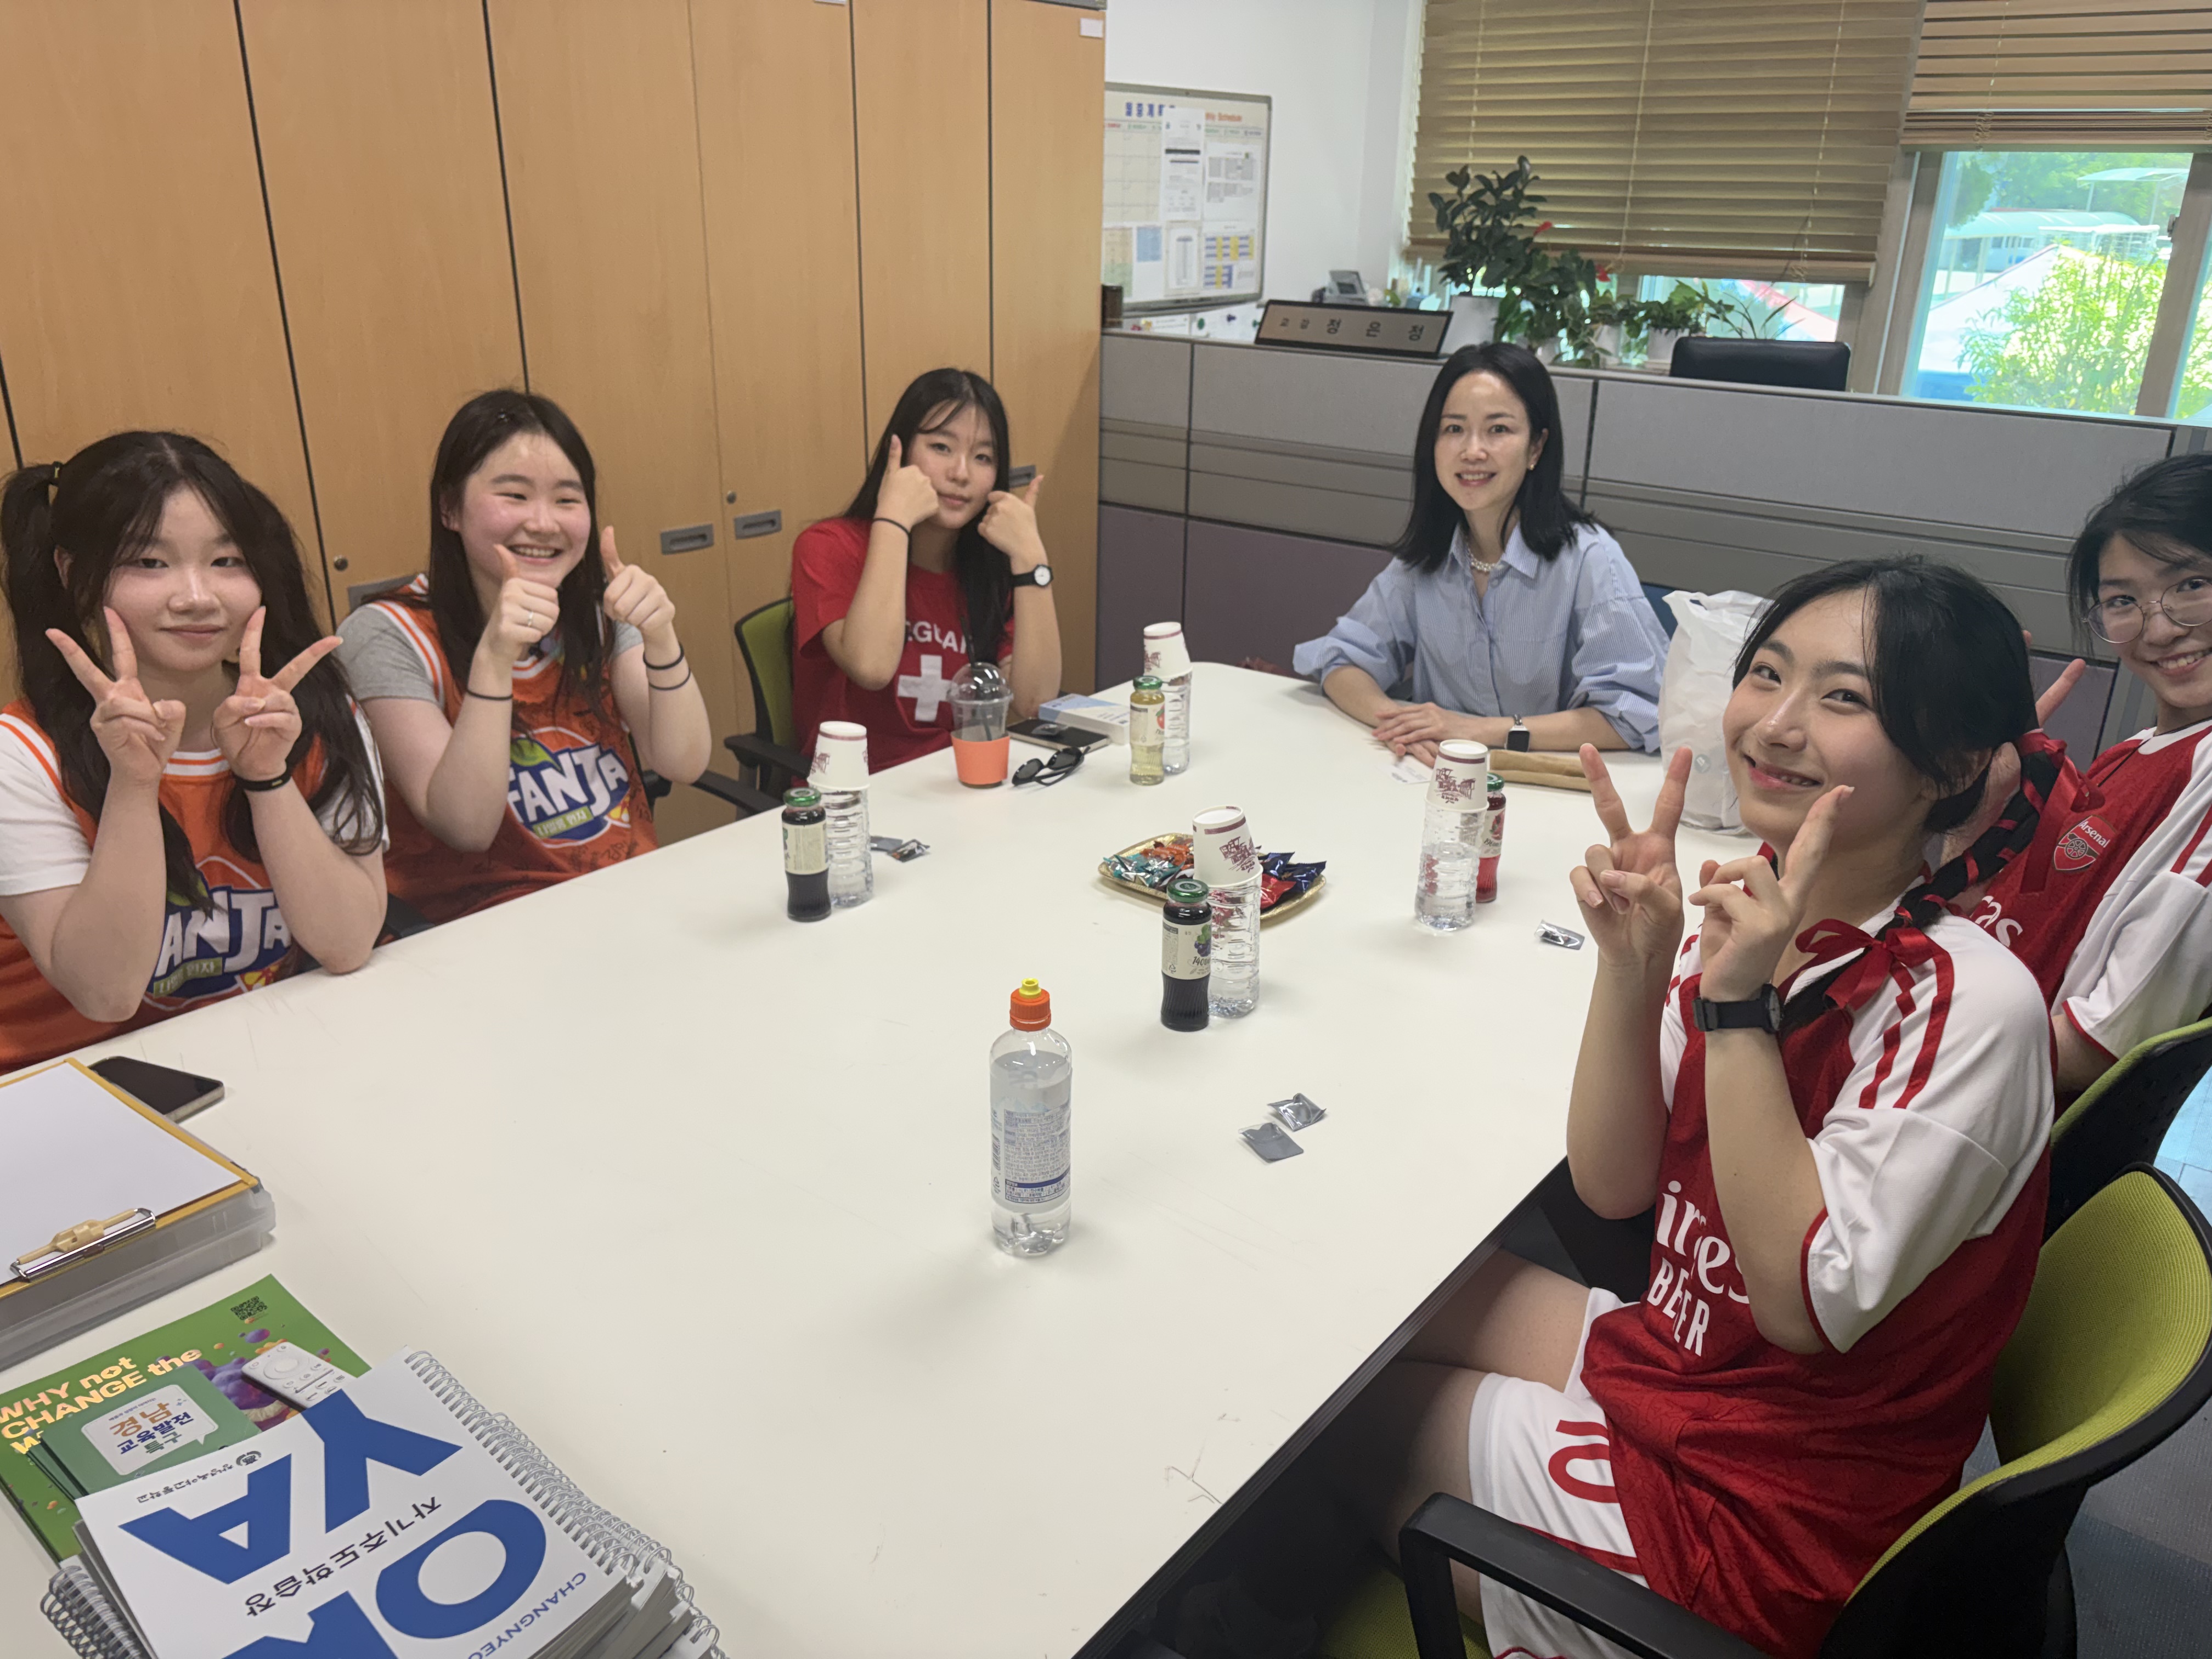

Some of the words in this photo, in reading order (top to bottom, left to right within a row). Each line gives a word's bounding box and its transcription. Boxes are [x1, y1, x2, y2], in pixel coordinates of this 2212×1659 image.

[906, 620, 967, 654] GUA
[2078, 820, 2111, 848] Arsenal
[154, 890, 292, 978] ANJA
[0, 1381, 69, 1424] WHY
[80, 1357, 137, 1390] not
[1, 1370, 147, 1439] CHANGE
[148, 1349, 202, 1376] the
[109, 1402, 173, 1437] 경남
[117, 1412, 194, 1454] 교육발전
[144, 1431, 182, 1454] 특구
[136, 1463, 234, 1504] 창녕옥야고등학교
[245, 1497, 442, 1617] 자기주도학습장
